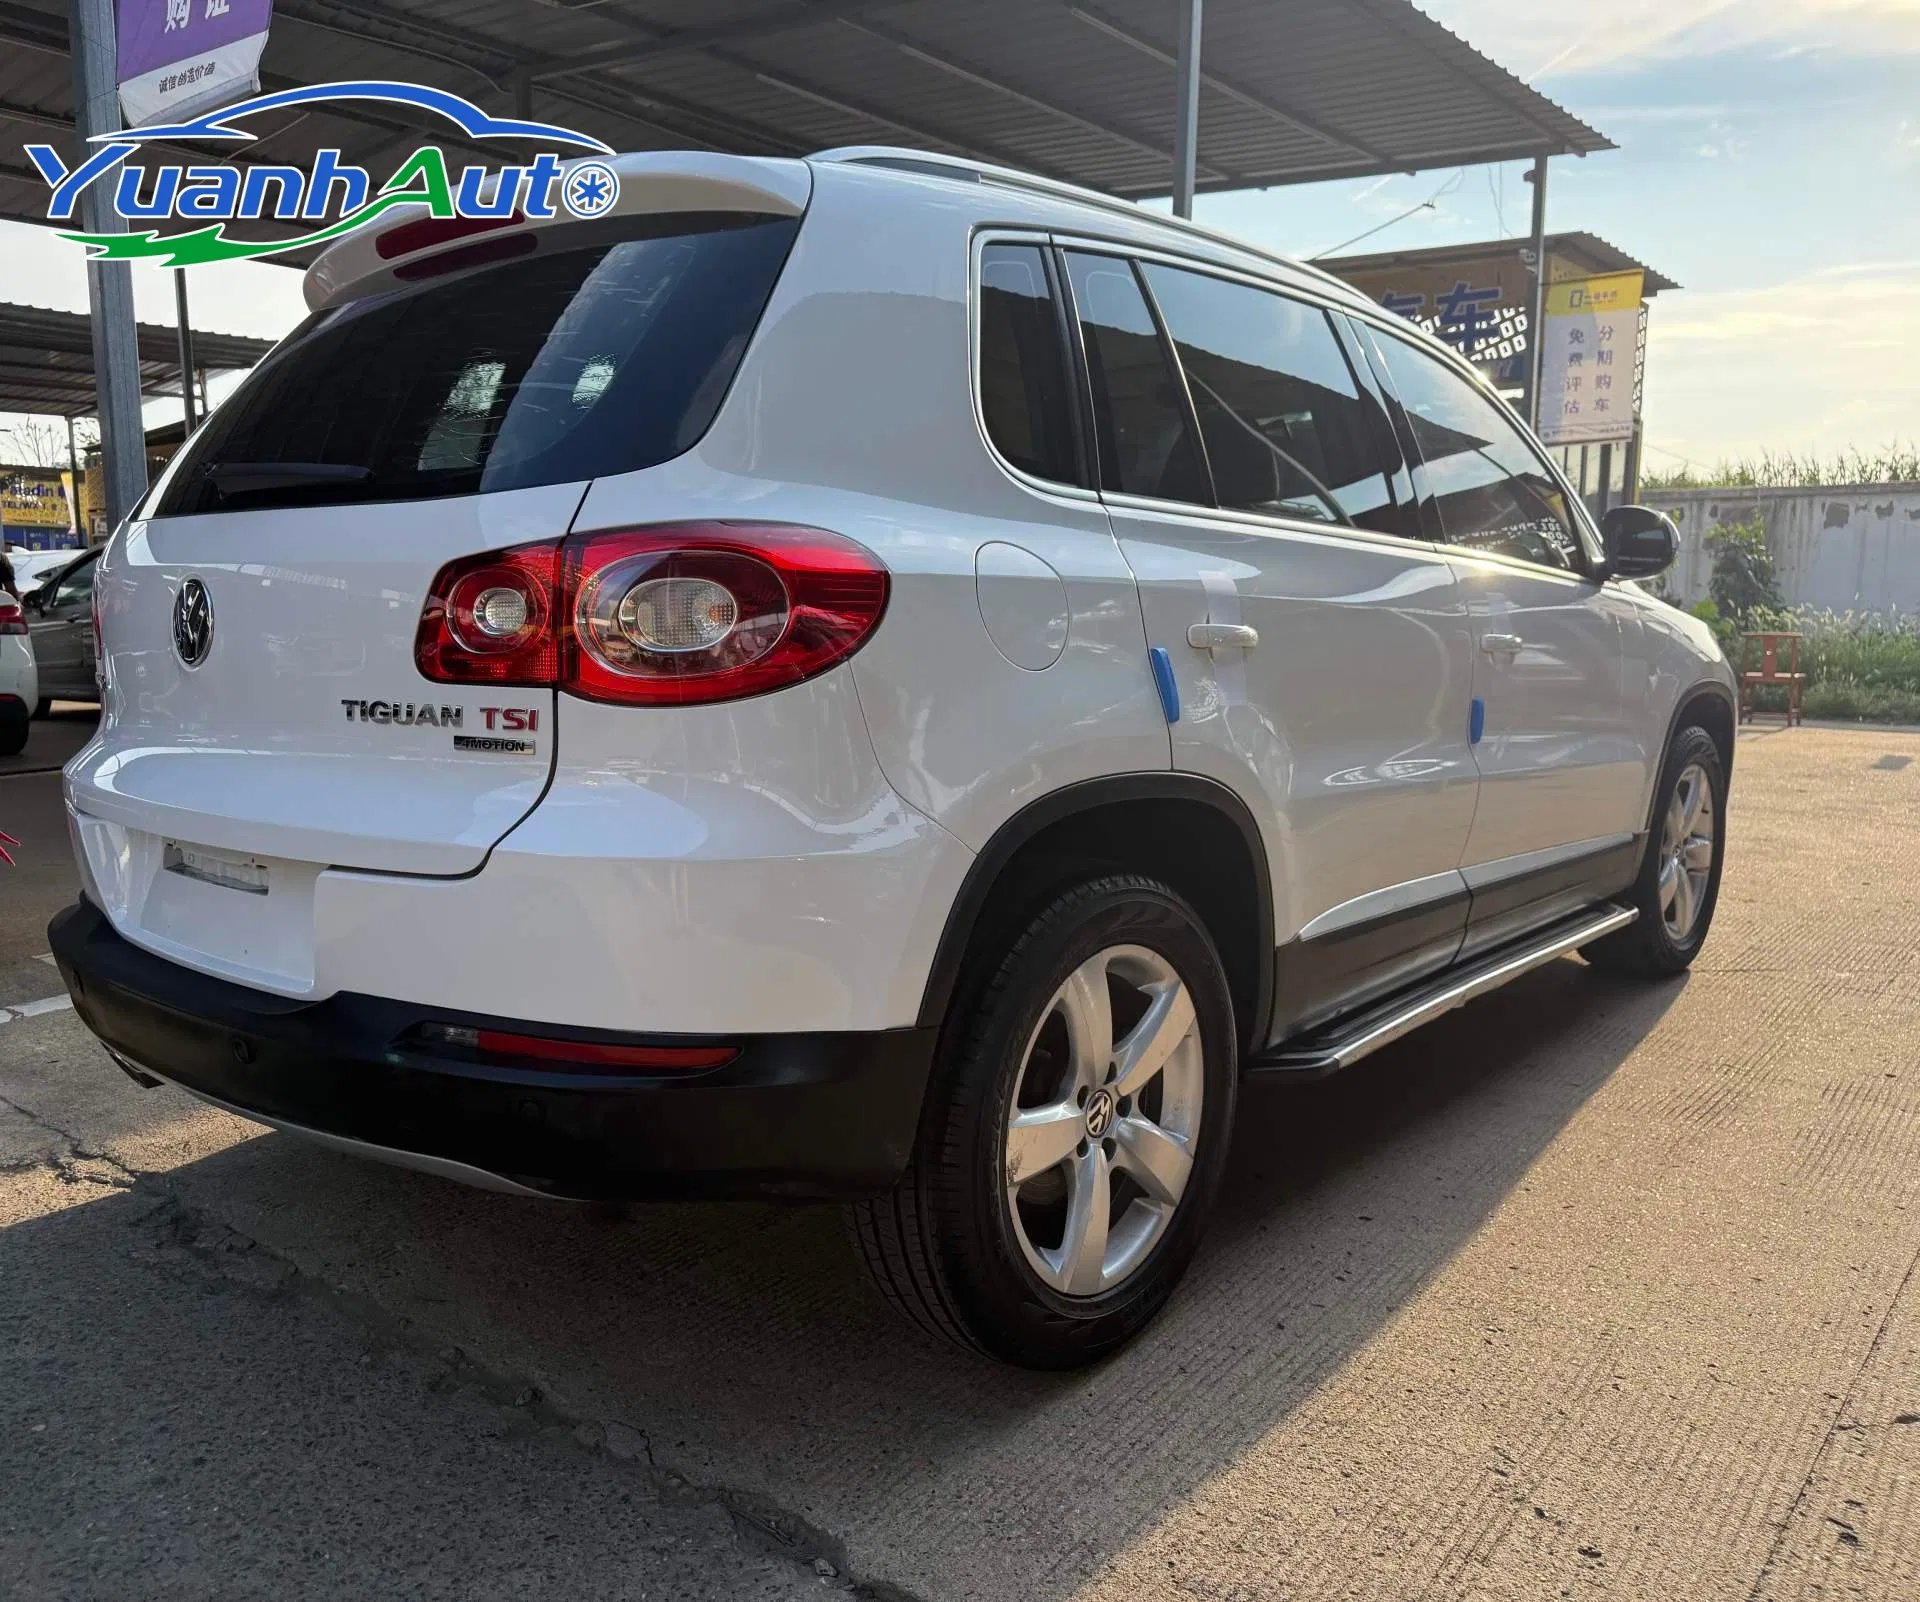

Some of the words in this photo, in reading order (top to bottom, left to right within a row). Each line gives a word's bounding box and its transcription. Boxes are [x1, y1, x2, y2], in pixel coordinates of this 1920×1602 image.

[158, 61, 216, 94] 诚信创造价值
[1594, 325, 1614, 412] 分期购车
[341, 699, 464, 728] TIGUAN
[480, 707, 540, 732] TSI
[463, 738, 526, 752] 4MOTION
